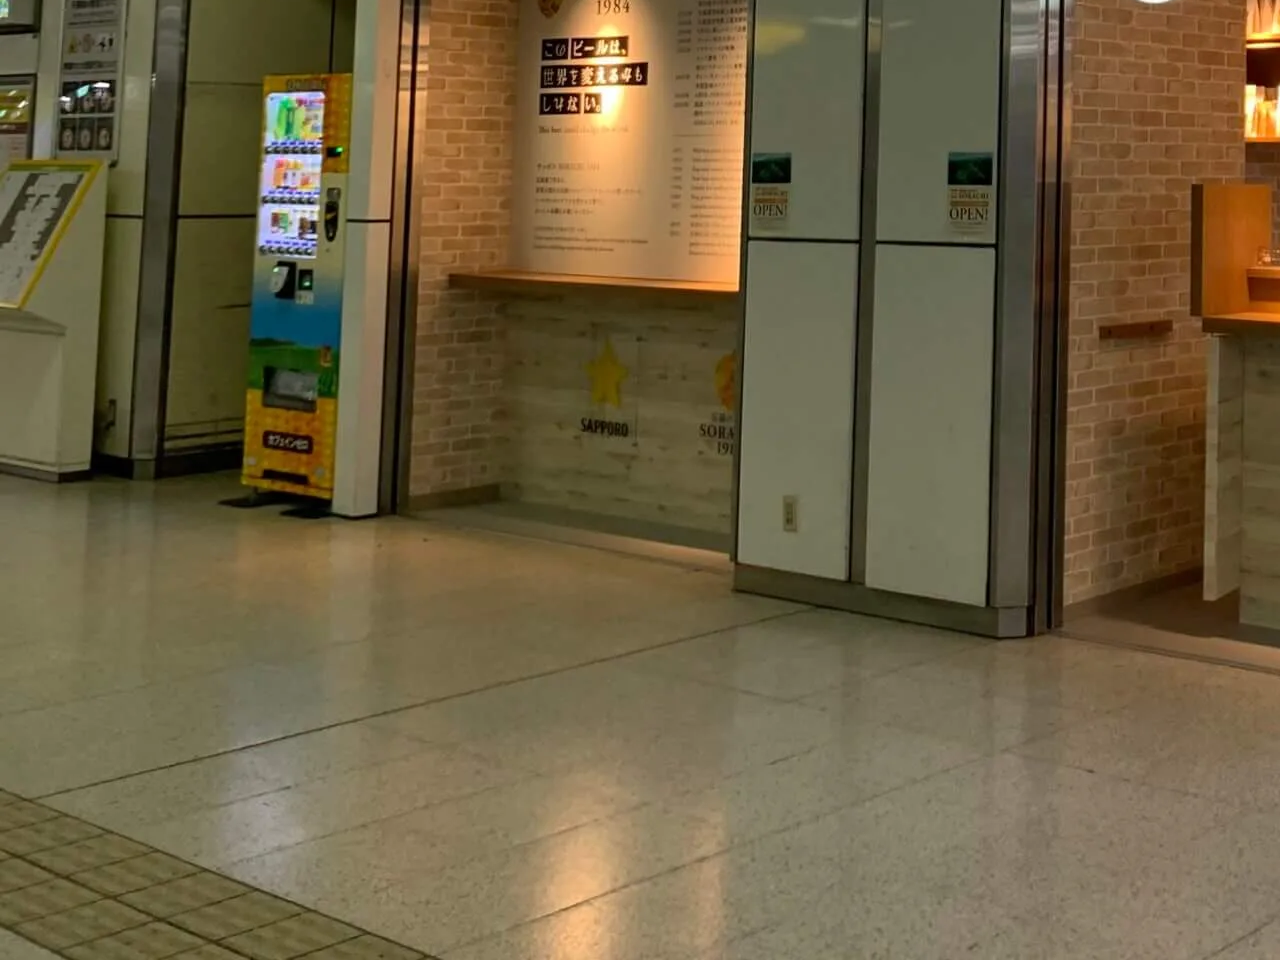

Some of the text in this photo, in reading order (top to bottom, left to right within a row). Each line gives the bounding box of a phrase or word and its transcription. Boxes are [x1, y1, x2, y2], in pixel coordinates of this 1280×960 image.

[753, 204, 788, 217] OPEN!
[949, 207, 989, 221] OPEN!
[580, 417, 630, 438] SAPPORO
[700, 423, 735, 440] SORA
